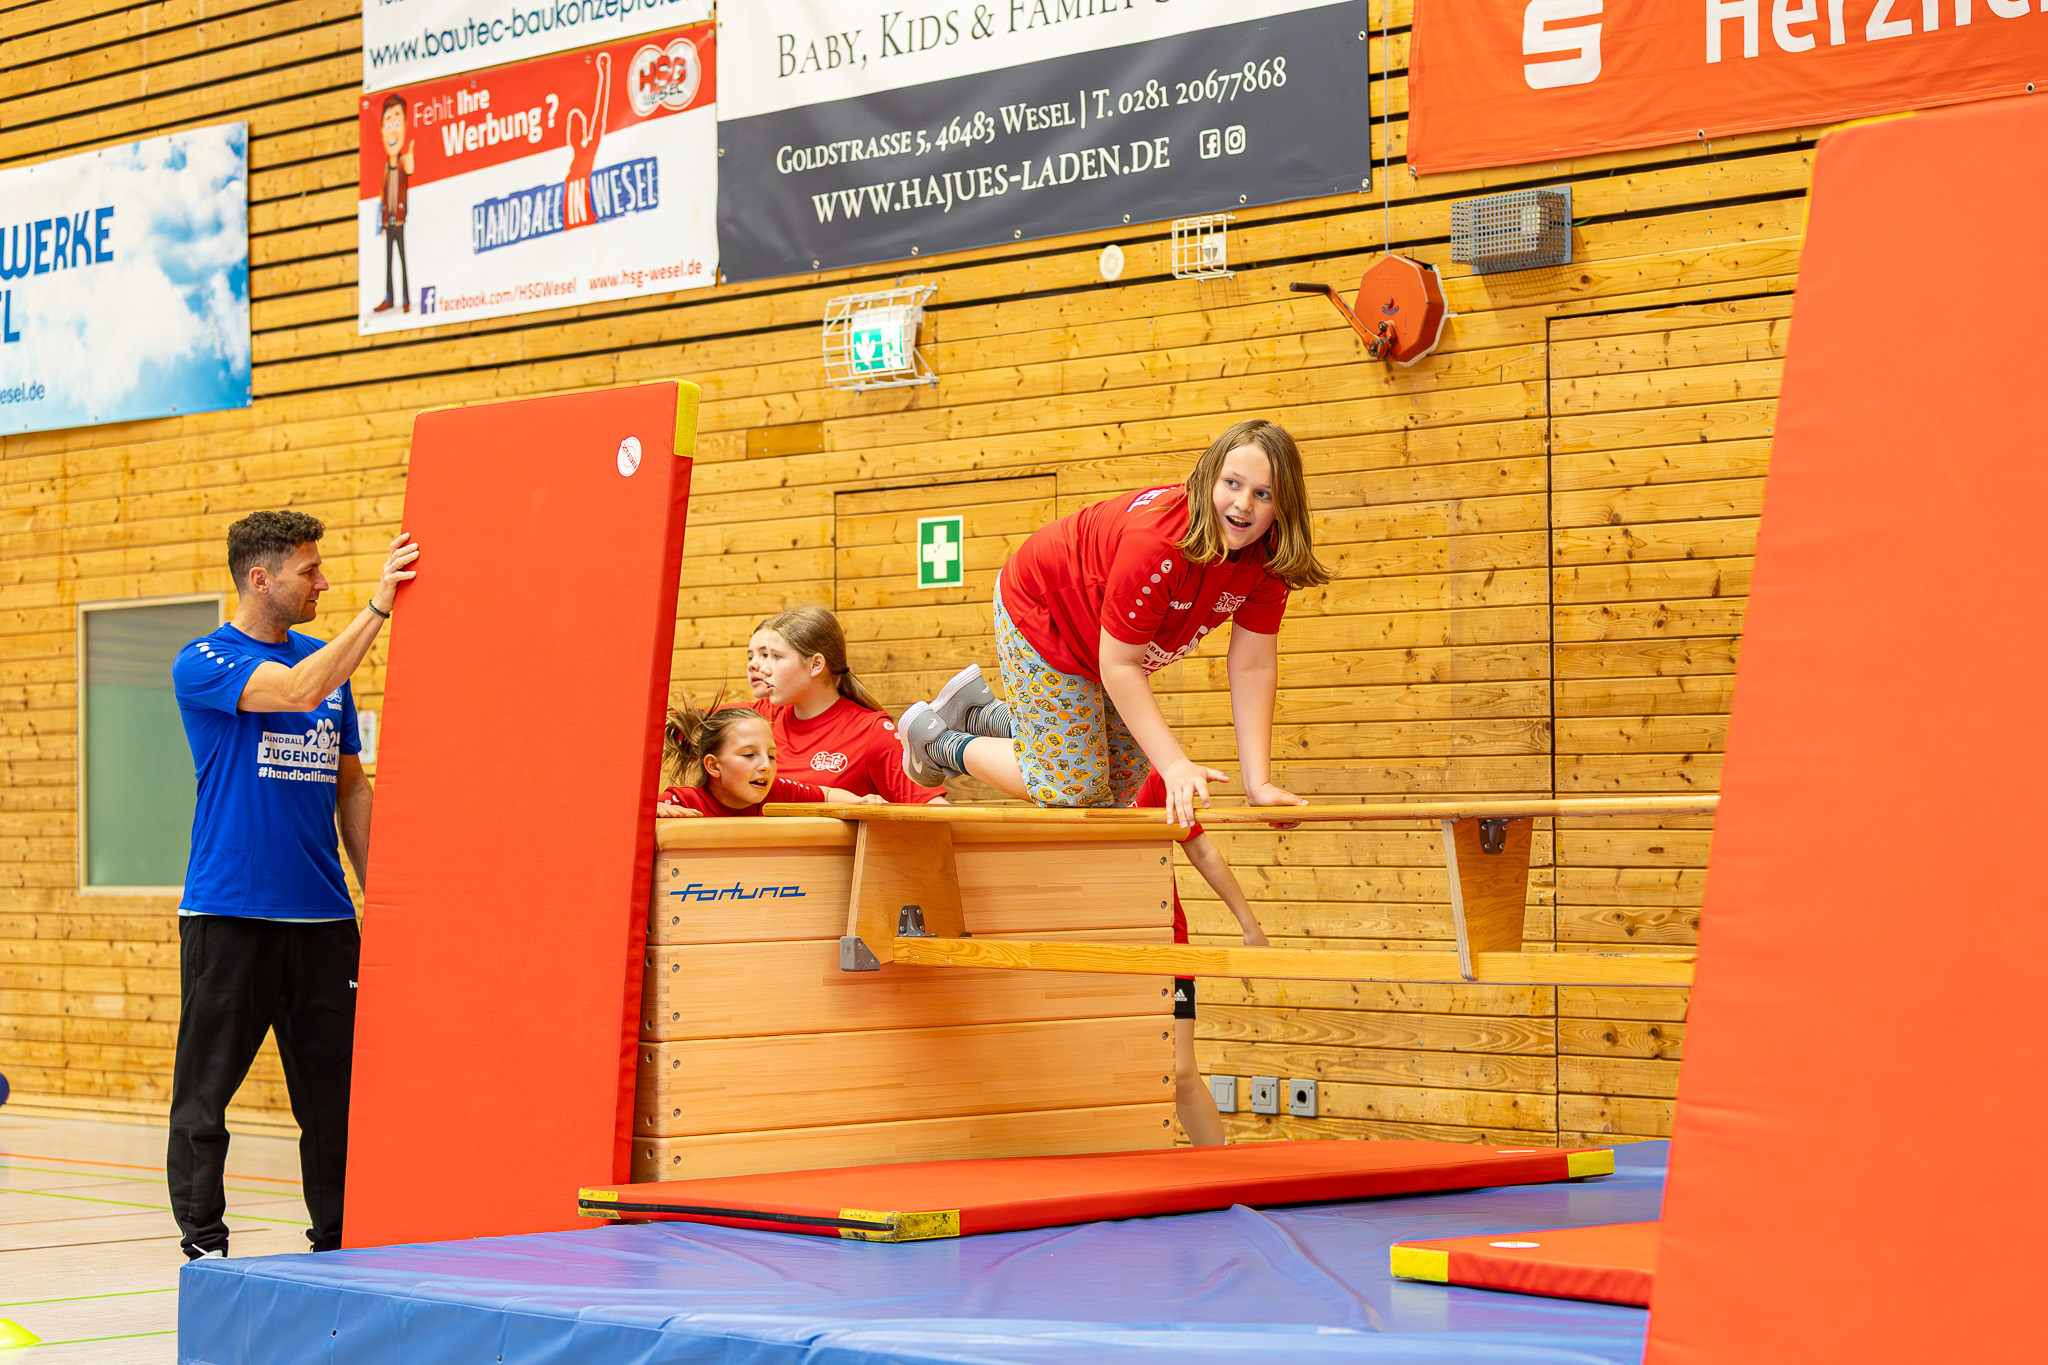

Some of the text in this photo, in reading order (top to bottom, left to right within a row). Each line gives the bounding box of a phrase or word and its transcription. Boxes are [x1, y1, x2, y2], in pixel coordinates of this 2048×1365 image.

[777, 30, 867, 78] BABY,
[880, 10, 959, 58] KIDS
[971, 4, 995, 40] &
[640, 55, 686, 93] HSG
[413, 89, 490, 128] Fehlt Ihre
[441, 107, 543, 157] Werbung
[776, 131, 912, 174] GOLDSTRASSE
[915, 130, 932, 156] 5,
[935, 111, 995, 151] 46483
[999, 102, 1075, 135] WESEL
[1092, 88, 1113, 119] T.
[1118, 79, 1170, 114] 0281
[1175, 56, 1287, 104] 20677868
[474, 161, 657, 249] HANDBALL IN WESEL
[811, 137, 1170, 224] WWW.HAJUES-LADEN.DE
[439, 259, 702, 312] facebook.com/HSGWesel www.hsg-wesel.de
[264, 735, 303, 746] HANDBALL
[669, 881, 806, 902] fortuna
